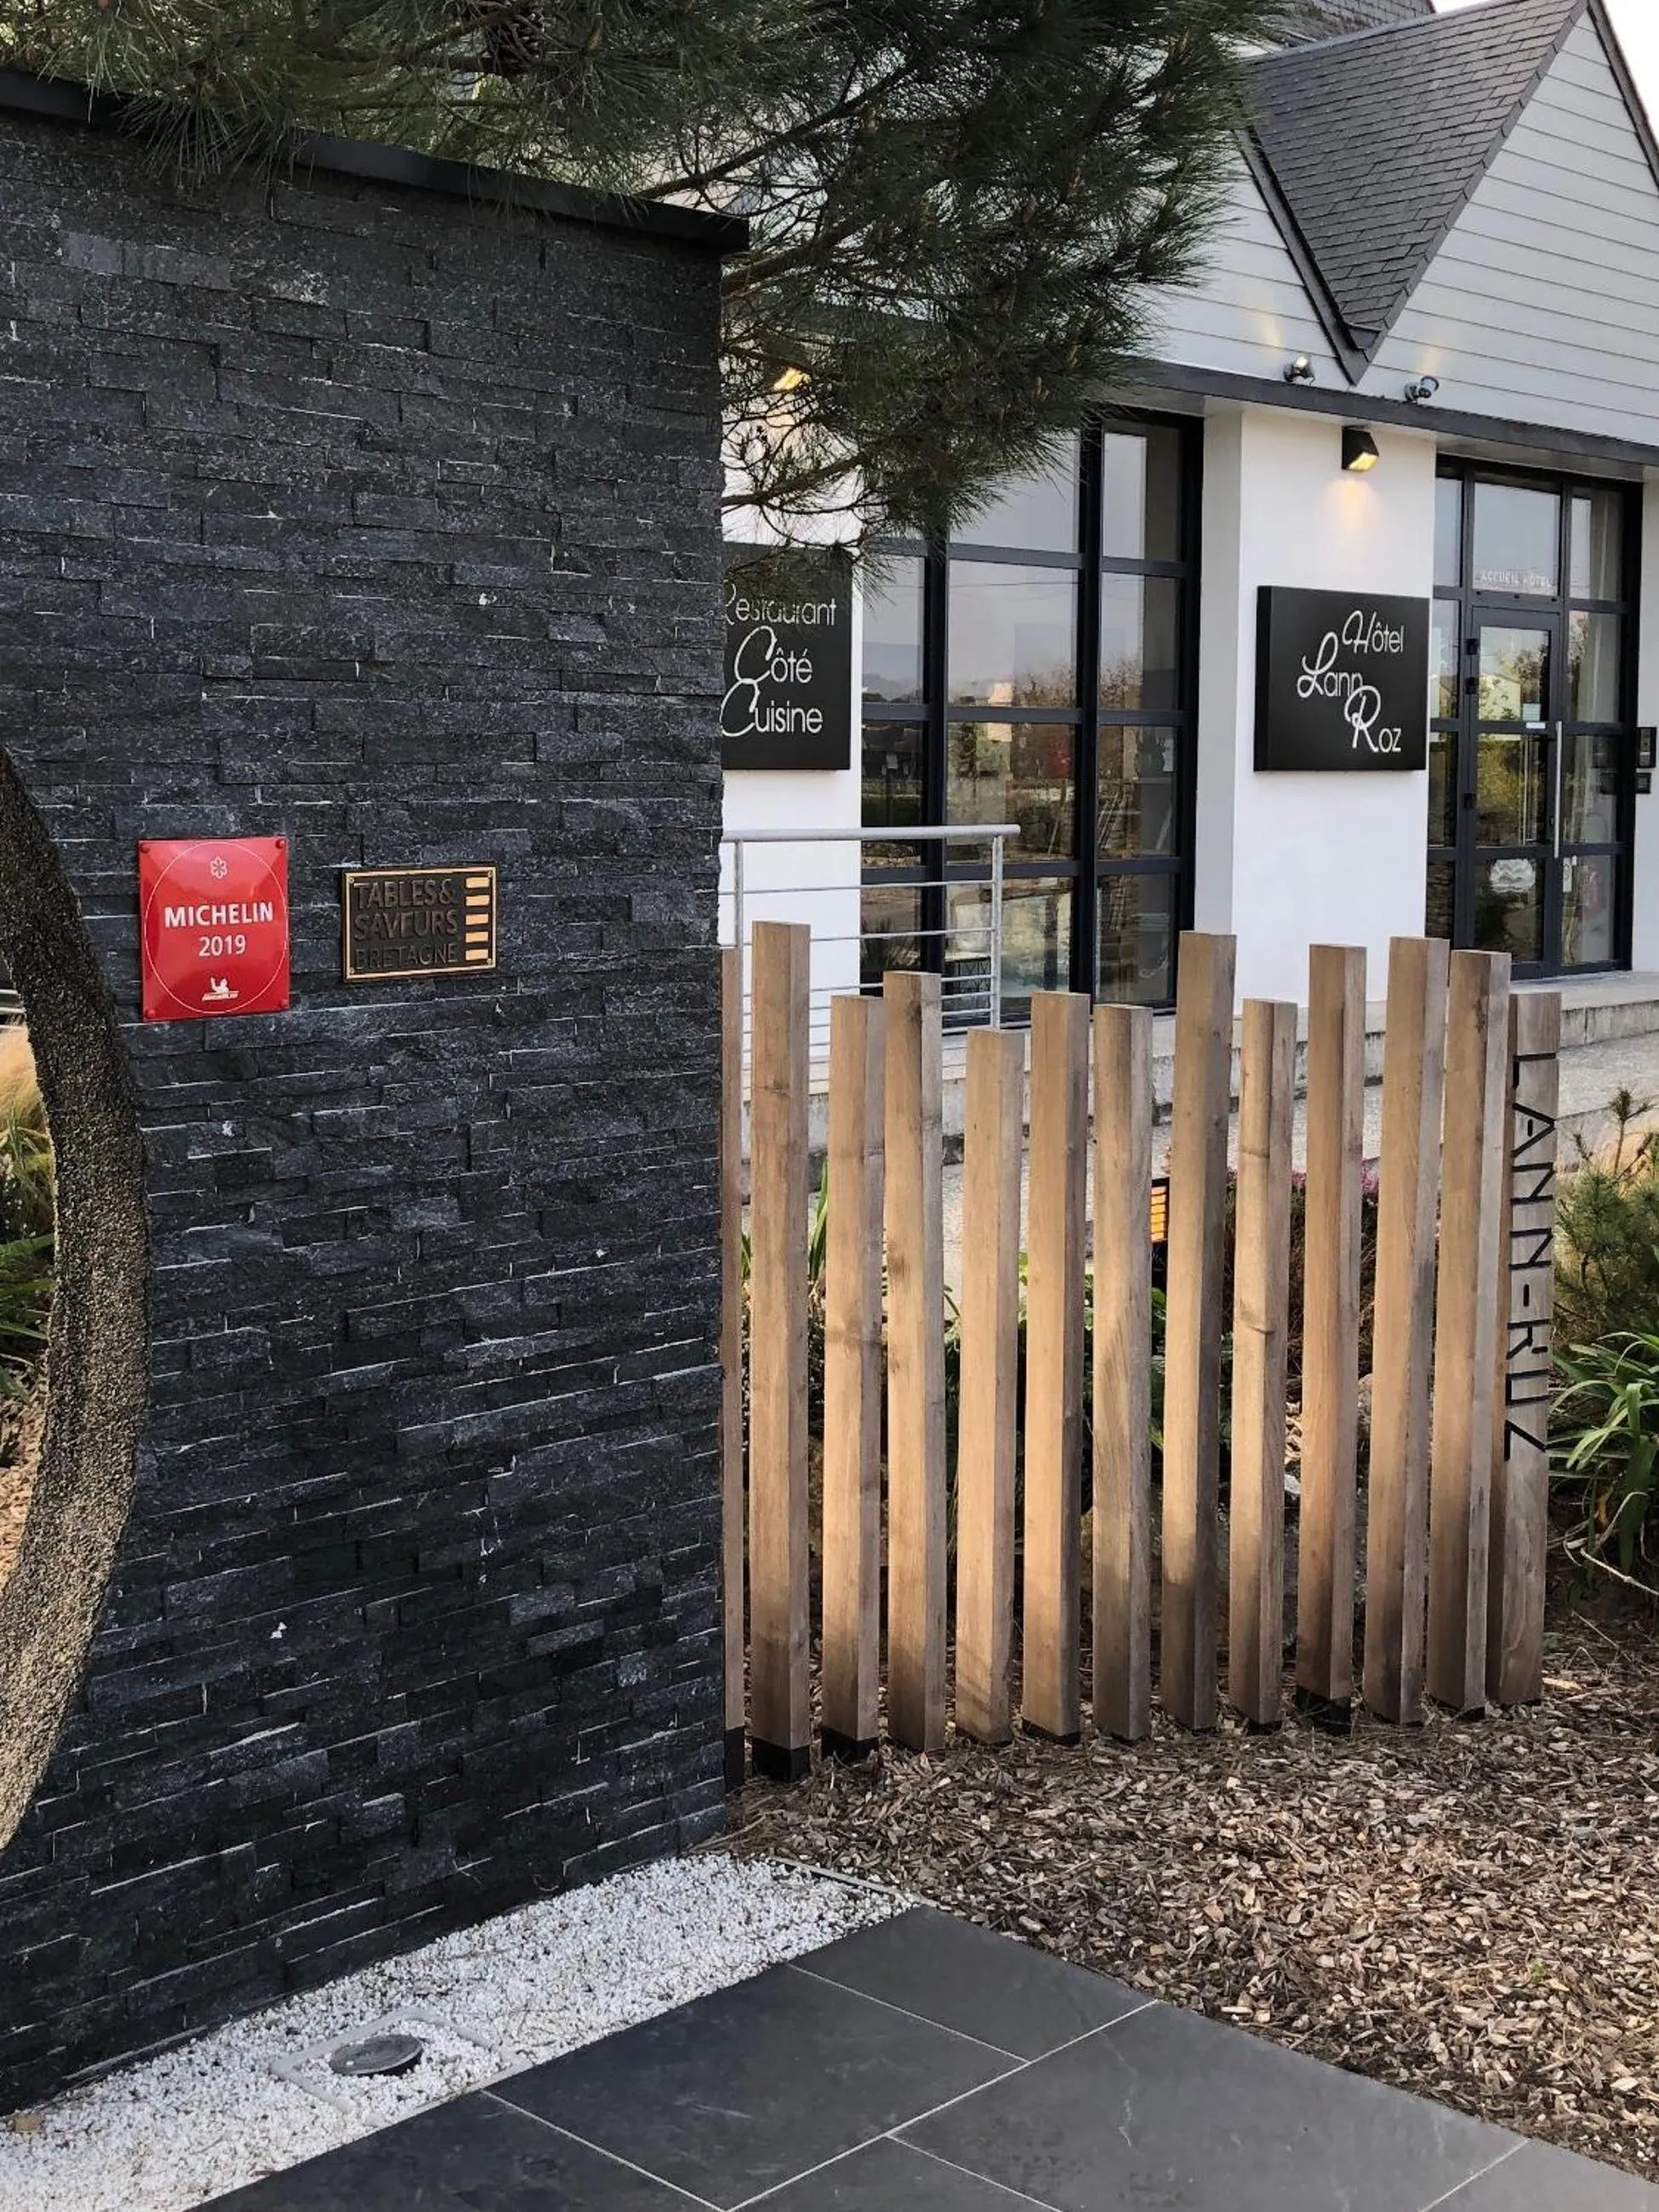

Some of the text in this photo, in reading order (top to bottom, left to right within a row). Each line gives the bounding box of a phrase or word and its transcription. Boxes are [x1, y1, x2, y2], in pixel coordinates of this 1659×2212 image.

[734, 624, 813, 684] Côté
[1342, 609, 1405, 654] Hôtel
[1297, 631, 1364, 698] Lann
[720, 678, 824, 738] Cuisine
[1343, 685, 1402, 753] Roz
[164, 900, 274, 928] MICHELIN
[353, 908, 459, 942] SAVEURS
[197, 934, 247, 958] 2019
[354, 942, 459, 970] BRETAGNE
